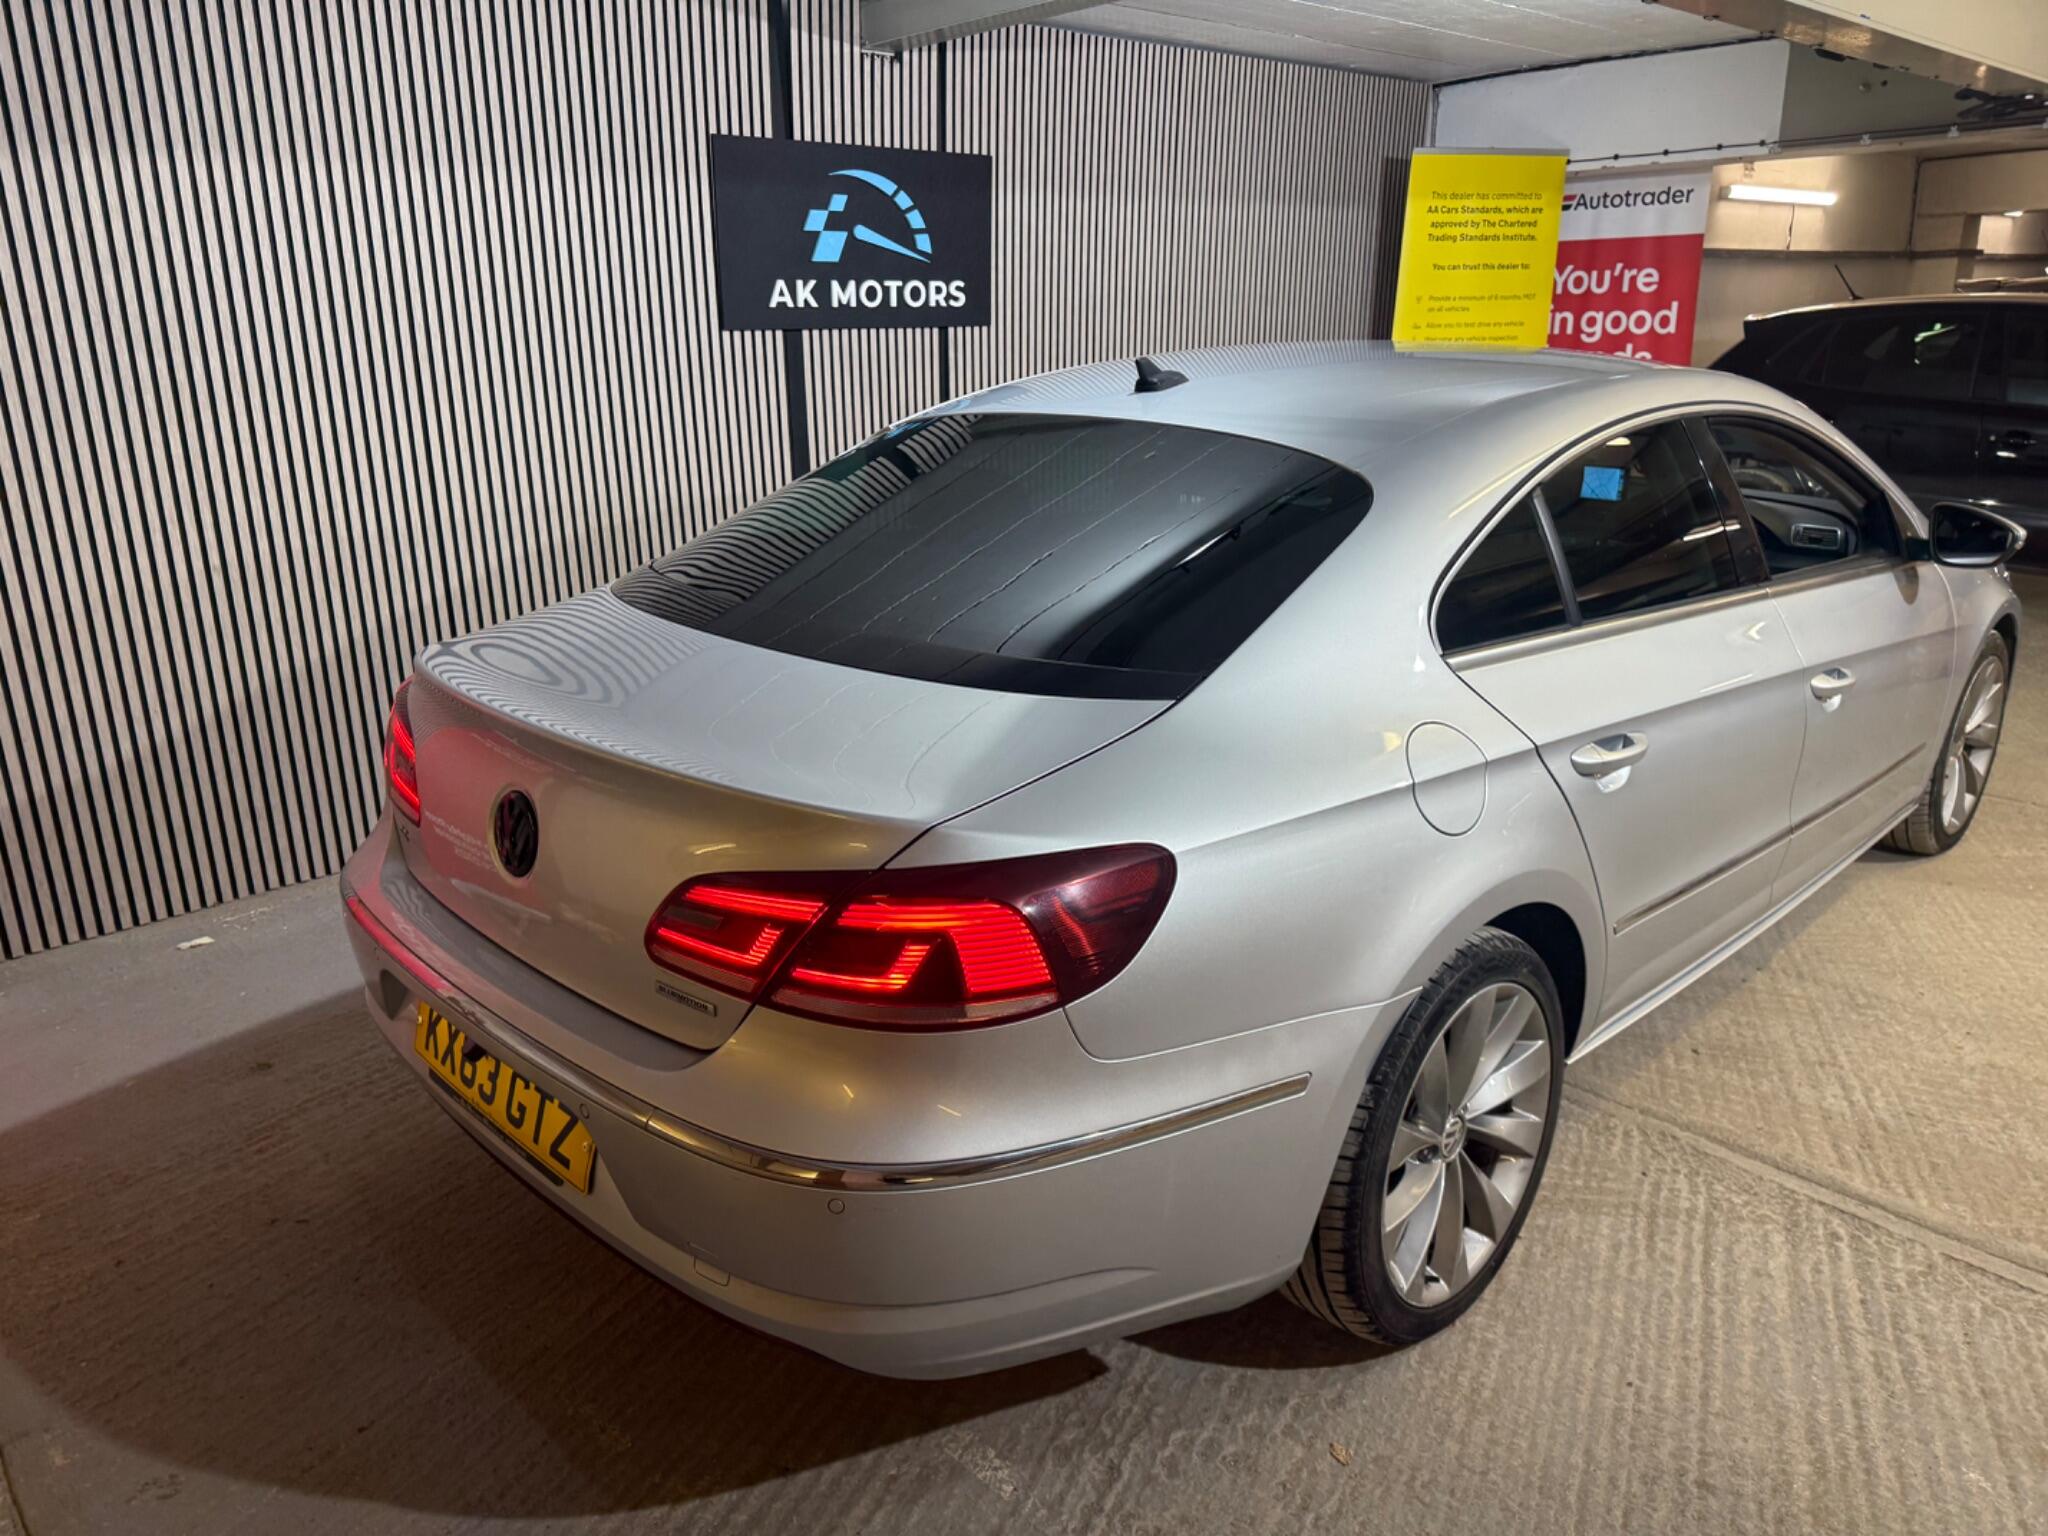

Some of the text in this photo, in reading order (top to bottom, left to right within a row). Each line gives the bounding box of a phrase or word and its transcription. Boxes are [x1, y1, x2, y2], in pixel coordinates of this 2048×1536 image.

[1432, 191, 1543, 200] This dealer has committed to
[1574, 186, 1694, 211] Autotrader
[1427, 204, 1544, 215] AA Cars Standards, which are
[1430, 219, 1538, 229] approved by The Chartered
[1428, 233, 1458, 243] Trading
[1459, 233, 1501, 242] Standards
[1433, 263, 1446, 271] You
[1447, 263, 1461, 271] can
[1462, 263, 1481, 271] trust
[1482, 262, 1495, 270] this
[1496, 262, 1520, 270] dealer
[1554, 263, 1660, 294] You're
[769, 279, 966, 308] AK MOTORS
[1580, 300, 1679, 343] good
[506, 1070, 579, 1171] GTZ
